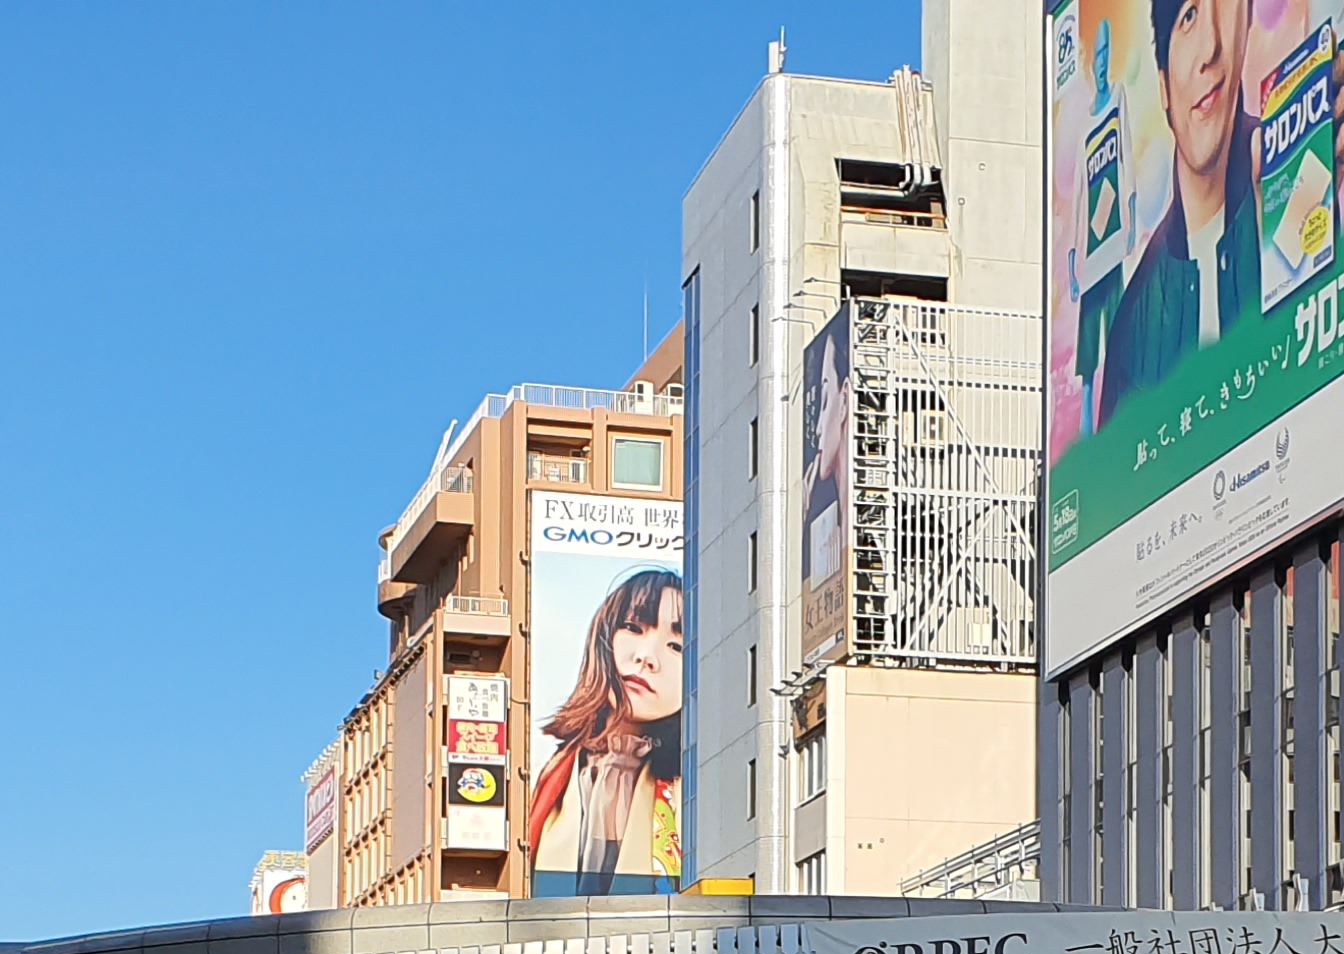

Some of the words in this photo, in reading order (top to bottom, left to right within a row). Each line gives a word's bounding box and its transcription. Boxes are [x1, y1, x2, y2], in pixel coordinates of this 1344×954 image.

[1264, 76, 1332, 165] サロンパス
[544, 499, 635, 526] FX取引高
[644, 507, 684, 529] 世界
